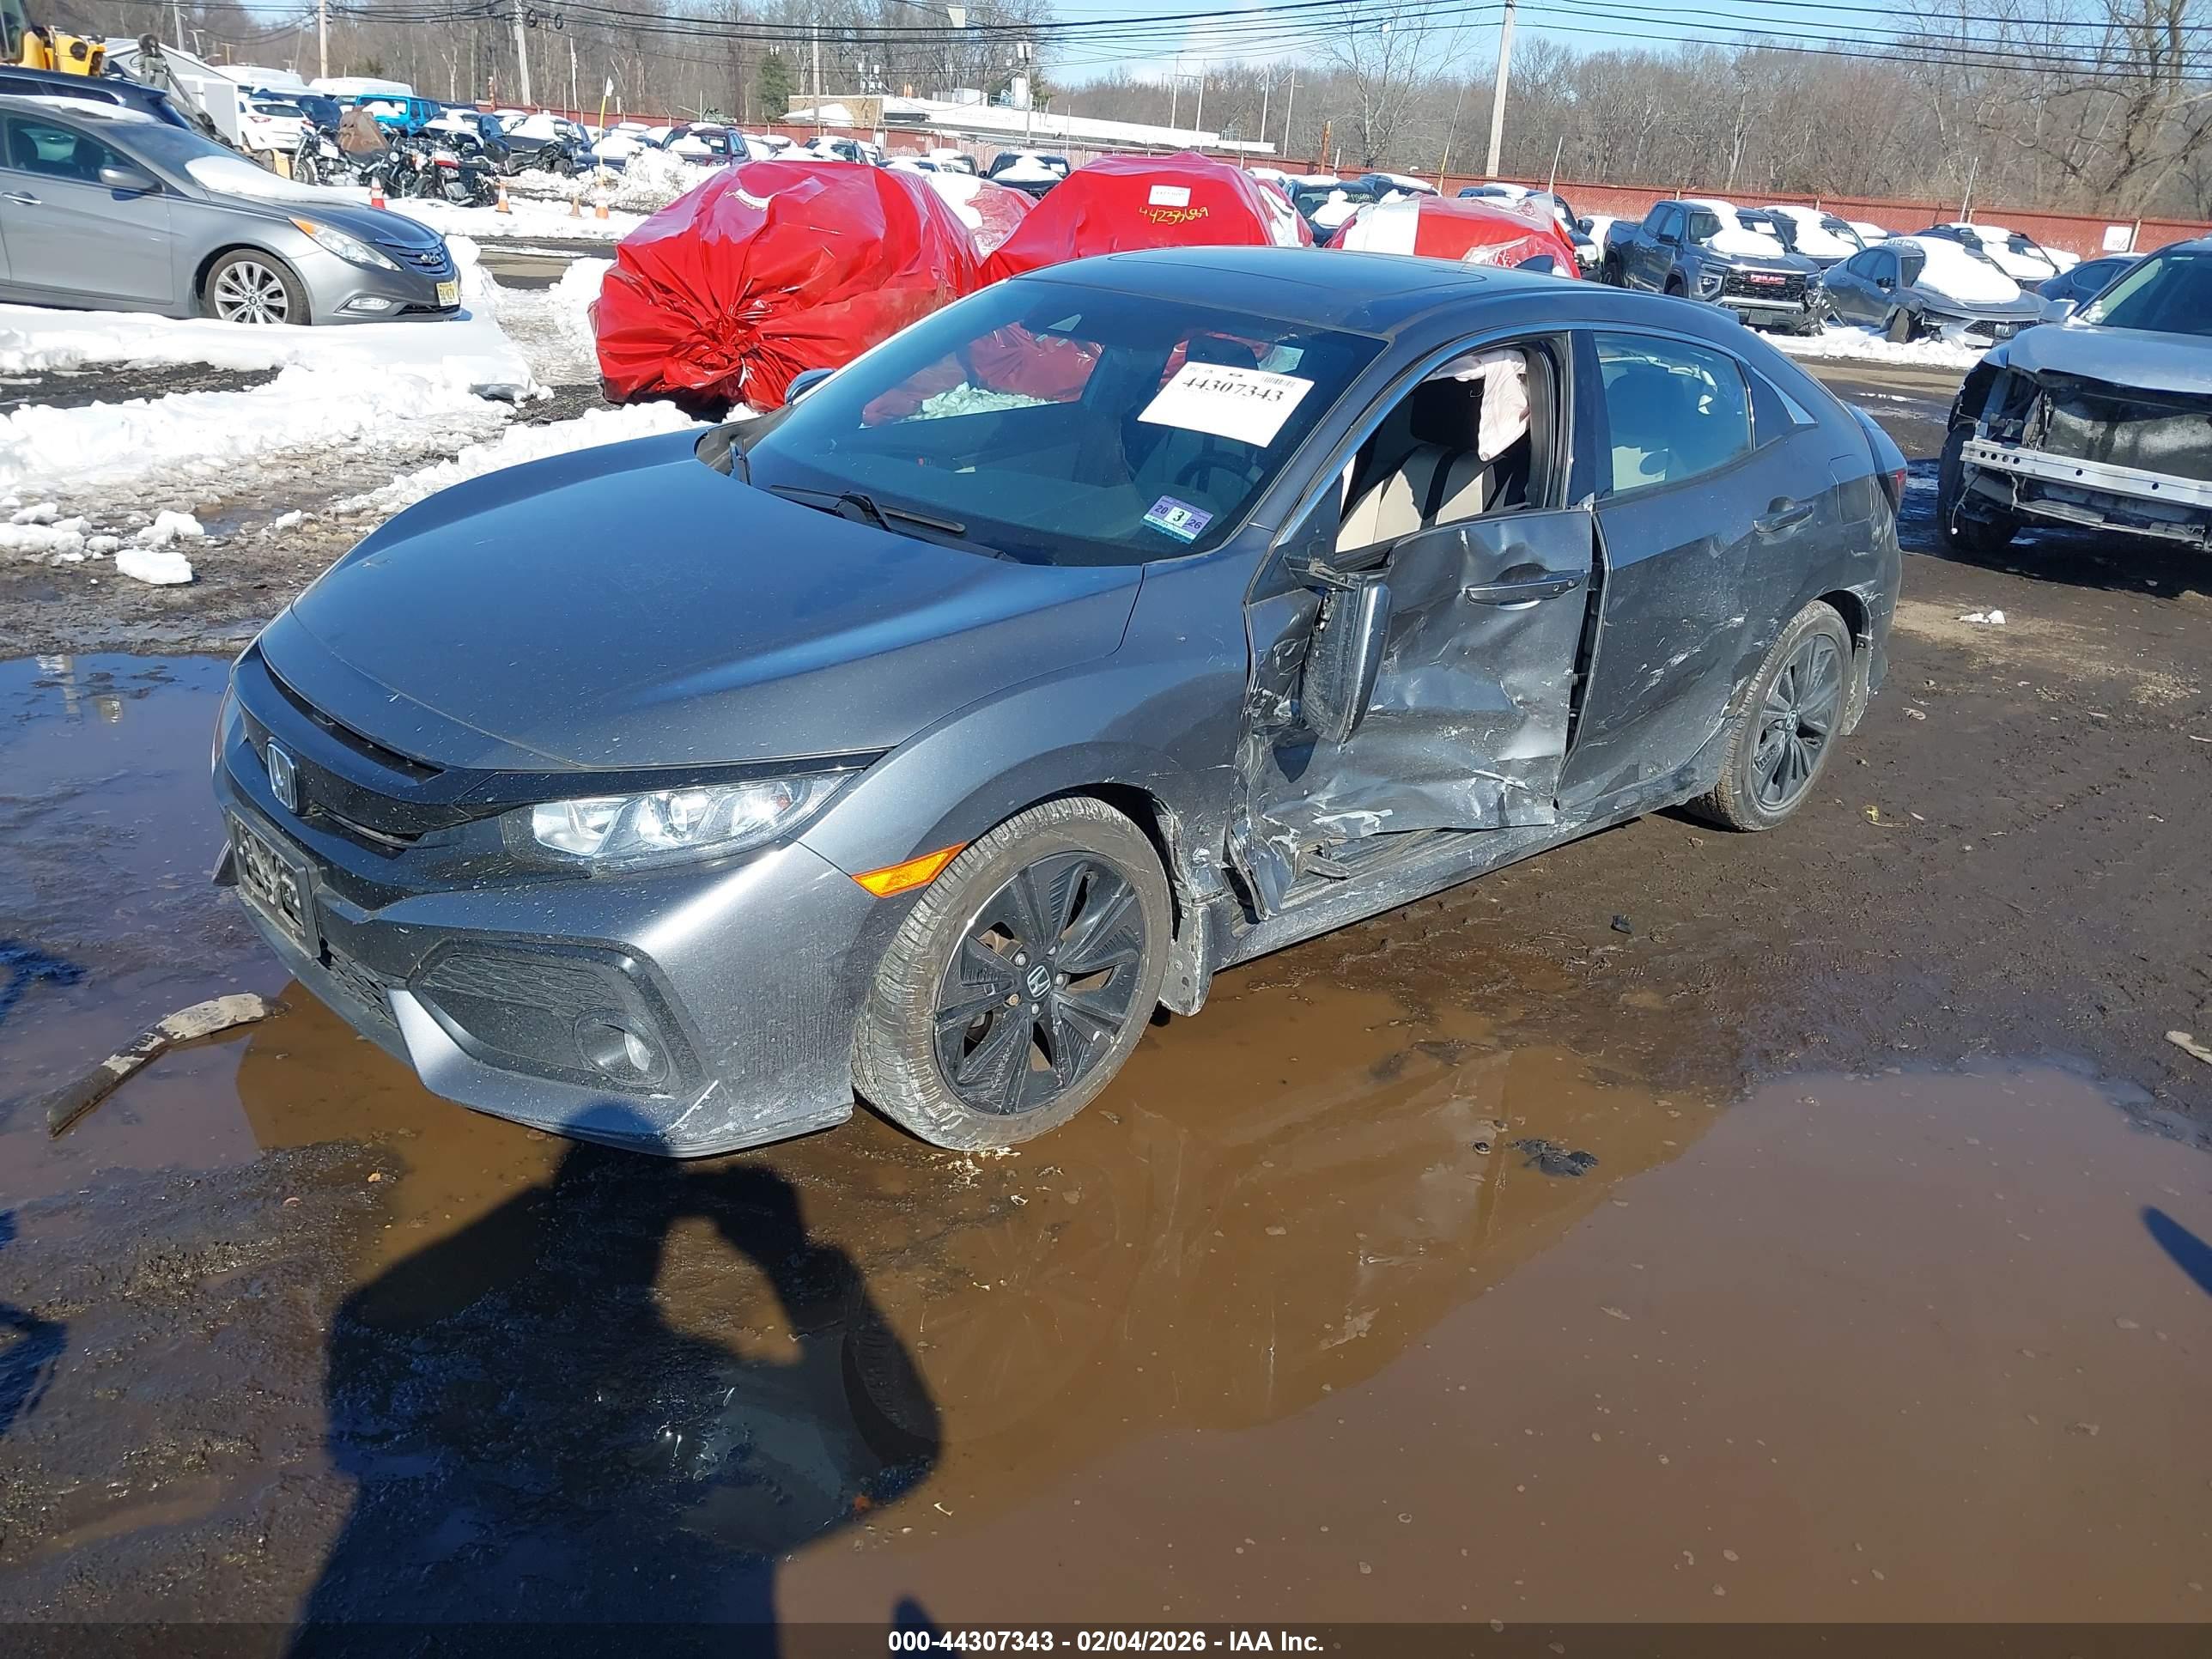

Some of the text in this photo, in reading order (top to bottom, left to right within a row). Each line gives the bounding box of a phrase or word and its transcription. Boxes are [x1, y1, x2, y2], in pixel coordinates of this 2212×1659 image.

[1183, 378, 1284, 401] 44307343
[1154, 504, 1169, 514] 20
[1173, 511, 1185, 522] 3
[1187, 519, 1202, 529] 26
